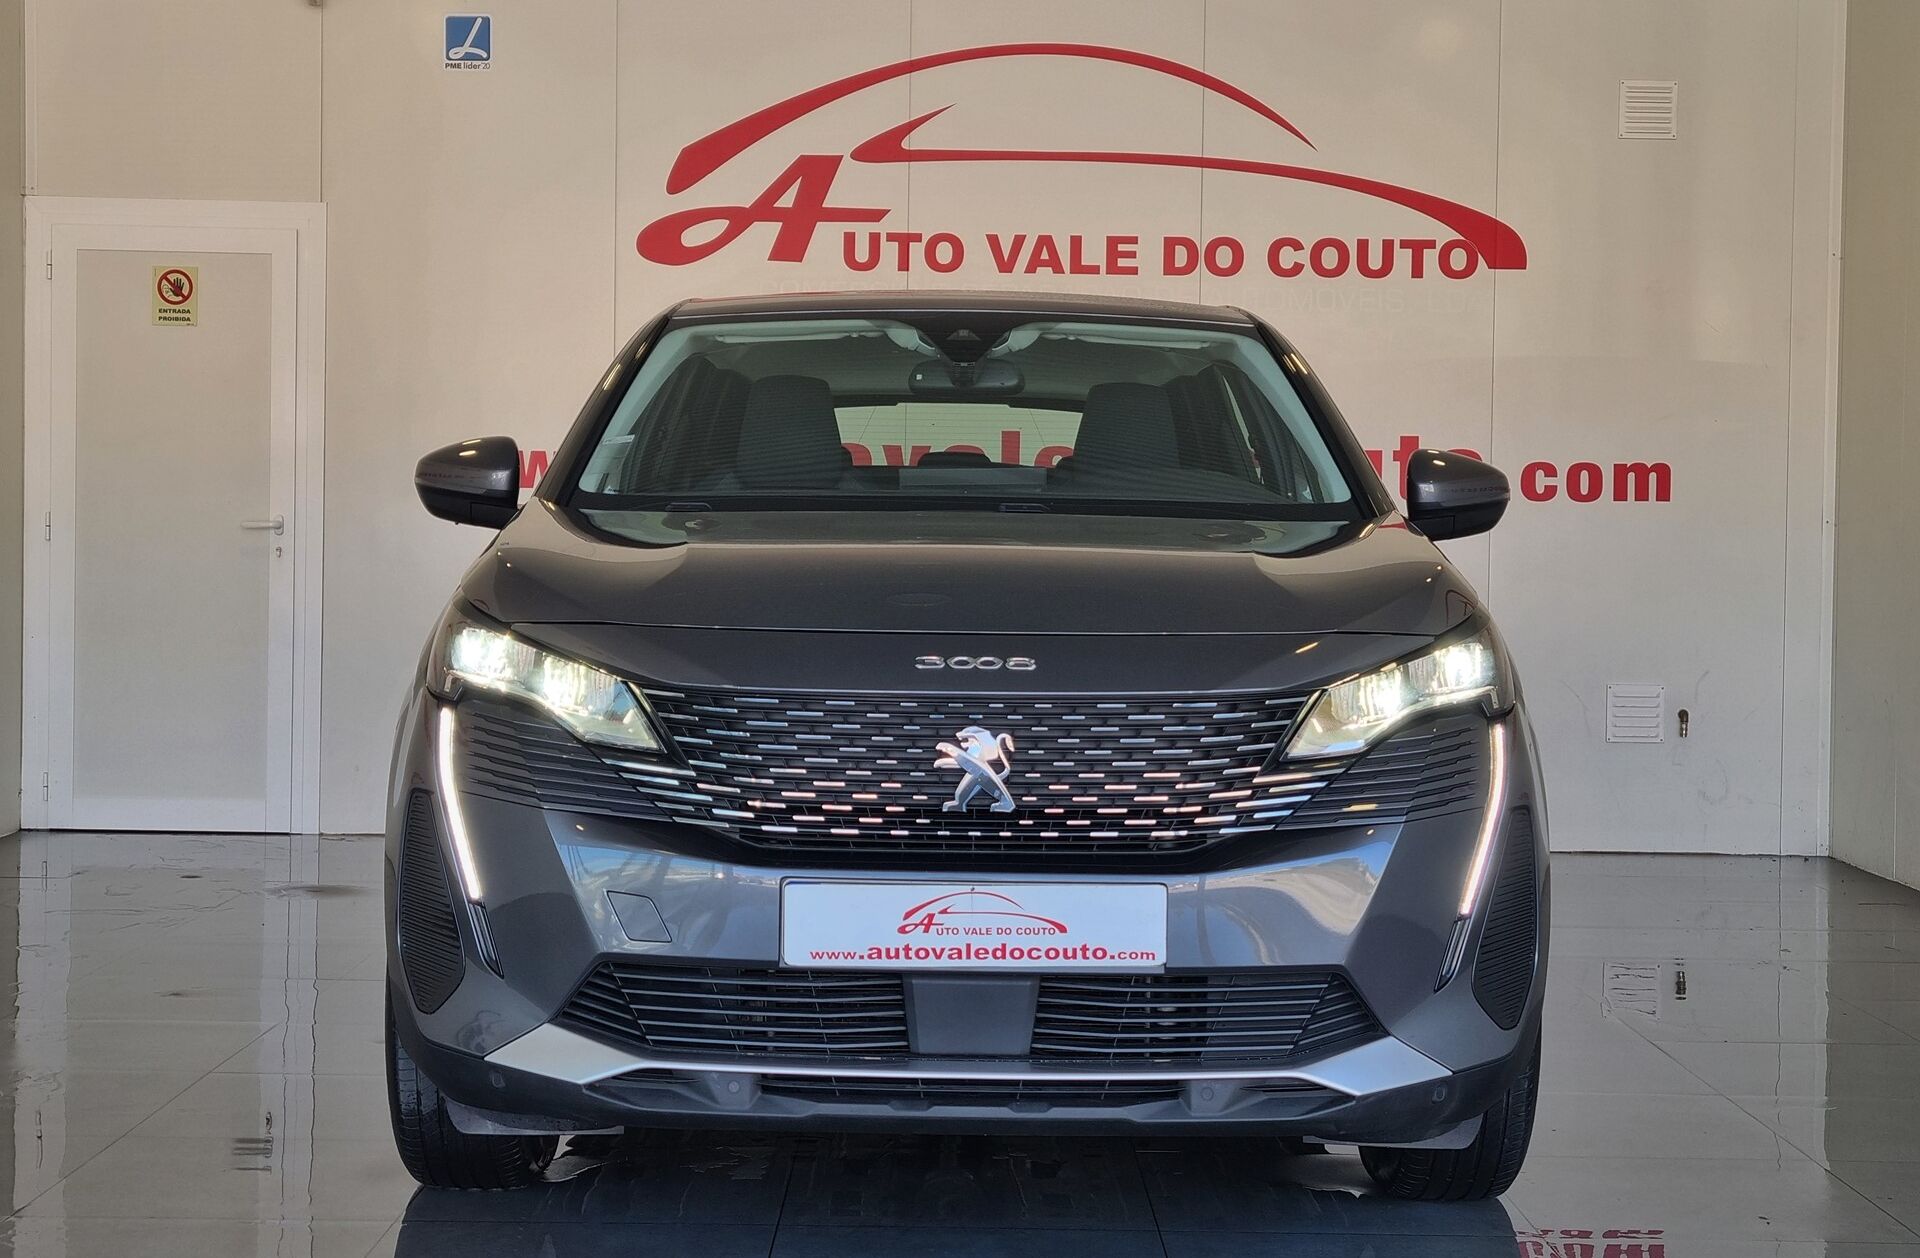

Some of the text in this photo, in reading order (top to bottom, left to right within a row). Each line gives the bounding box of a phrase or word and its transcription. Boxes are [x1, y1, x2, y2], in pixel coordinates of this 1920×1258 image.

[444, 62, 462, 70] PME
[636, 155, 1480, 280] AUTO VALE DO COUTO
[914, 655, 1037, 671] 3008
[897, 912, 1056, 936] AUTO VALE DO COUTO
[810, 942, 1156, 961] www.autovaledocouto.com
